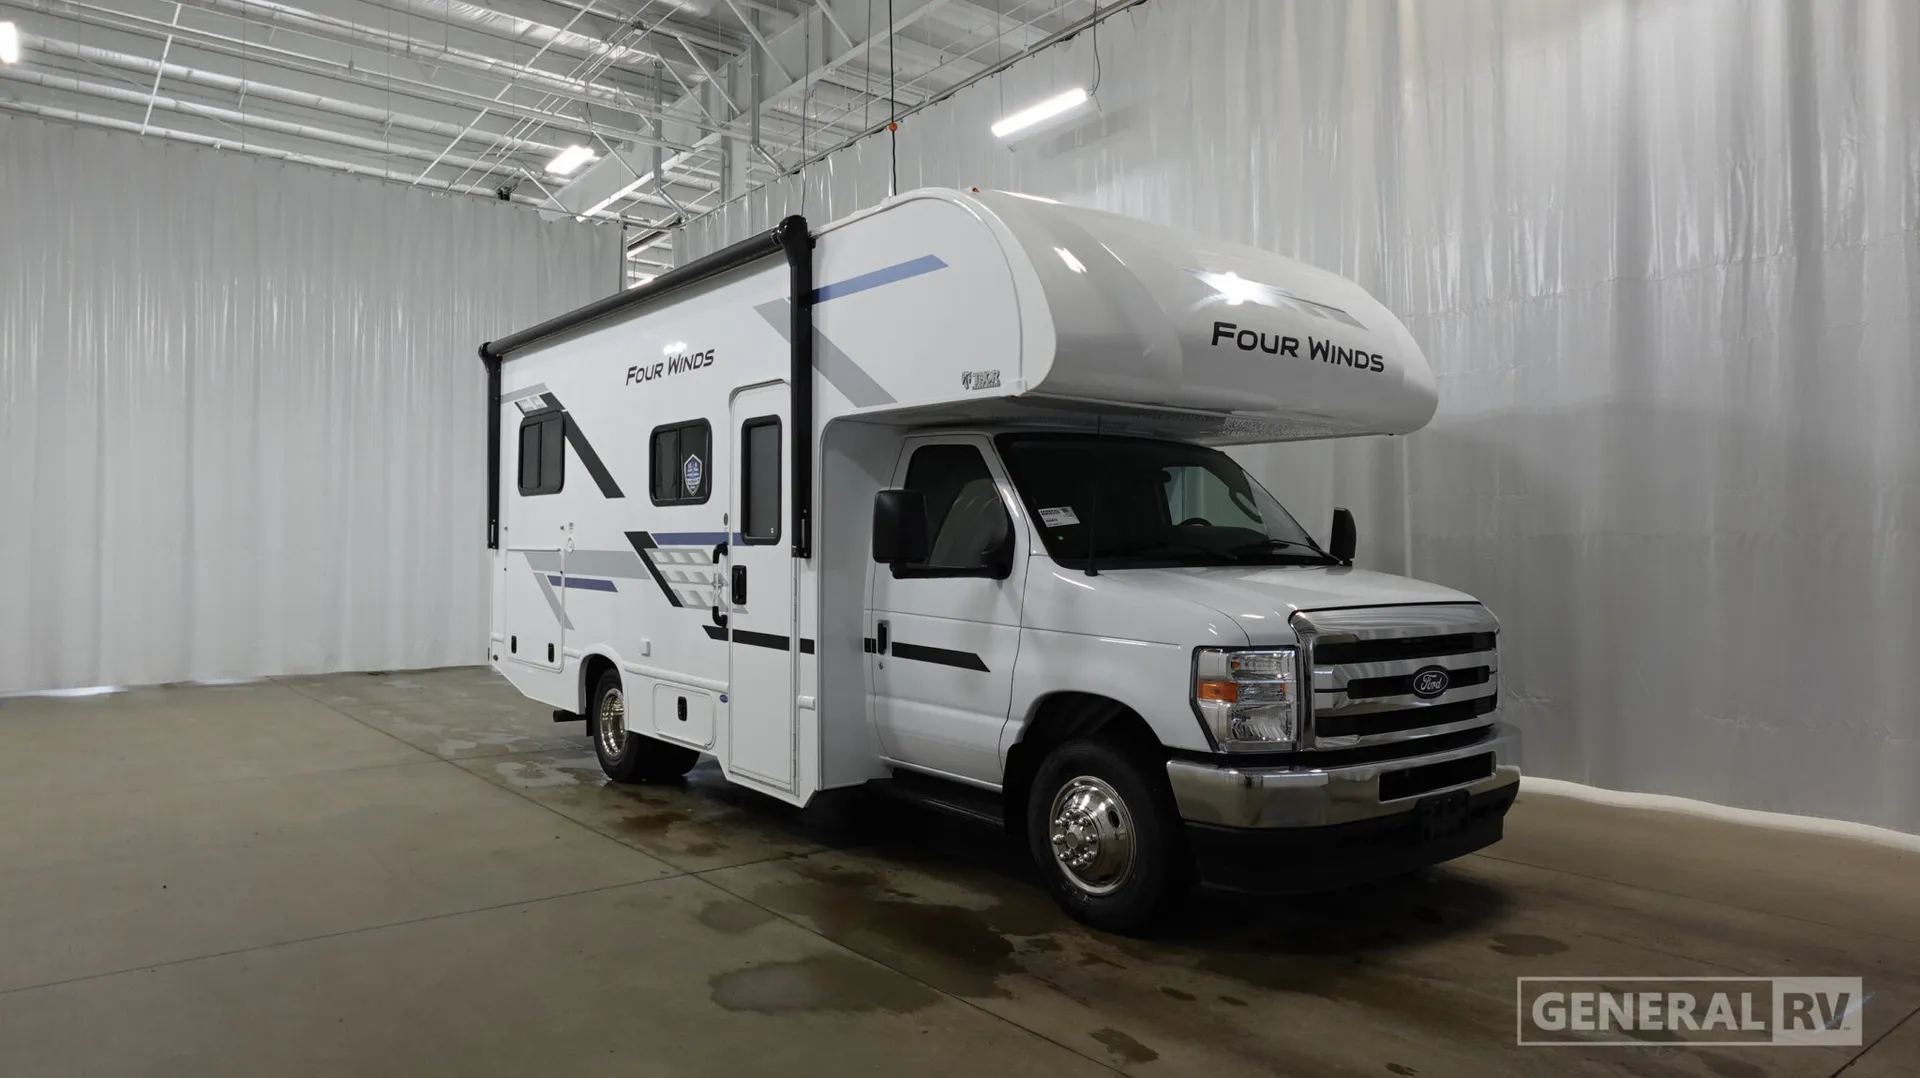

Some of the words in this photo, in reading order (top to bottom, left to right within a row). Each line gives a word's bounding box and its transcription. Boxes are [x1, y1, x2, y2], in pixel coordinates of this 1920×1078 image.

[1211, 321, 1299, 358] FOUR
[1308, 336, 1384, 373] WINDS
[625, 363, 664, 385] FOUR
[668, 349, 714, 375] WINDS
[1420, 674, 1442, 691] Ford
